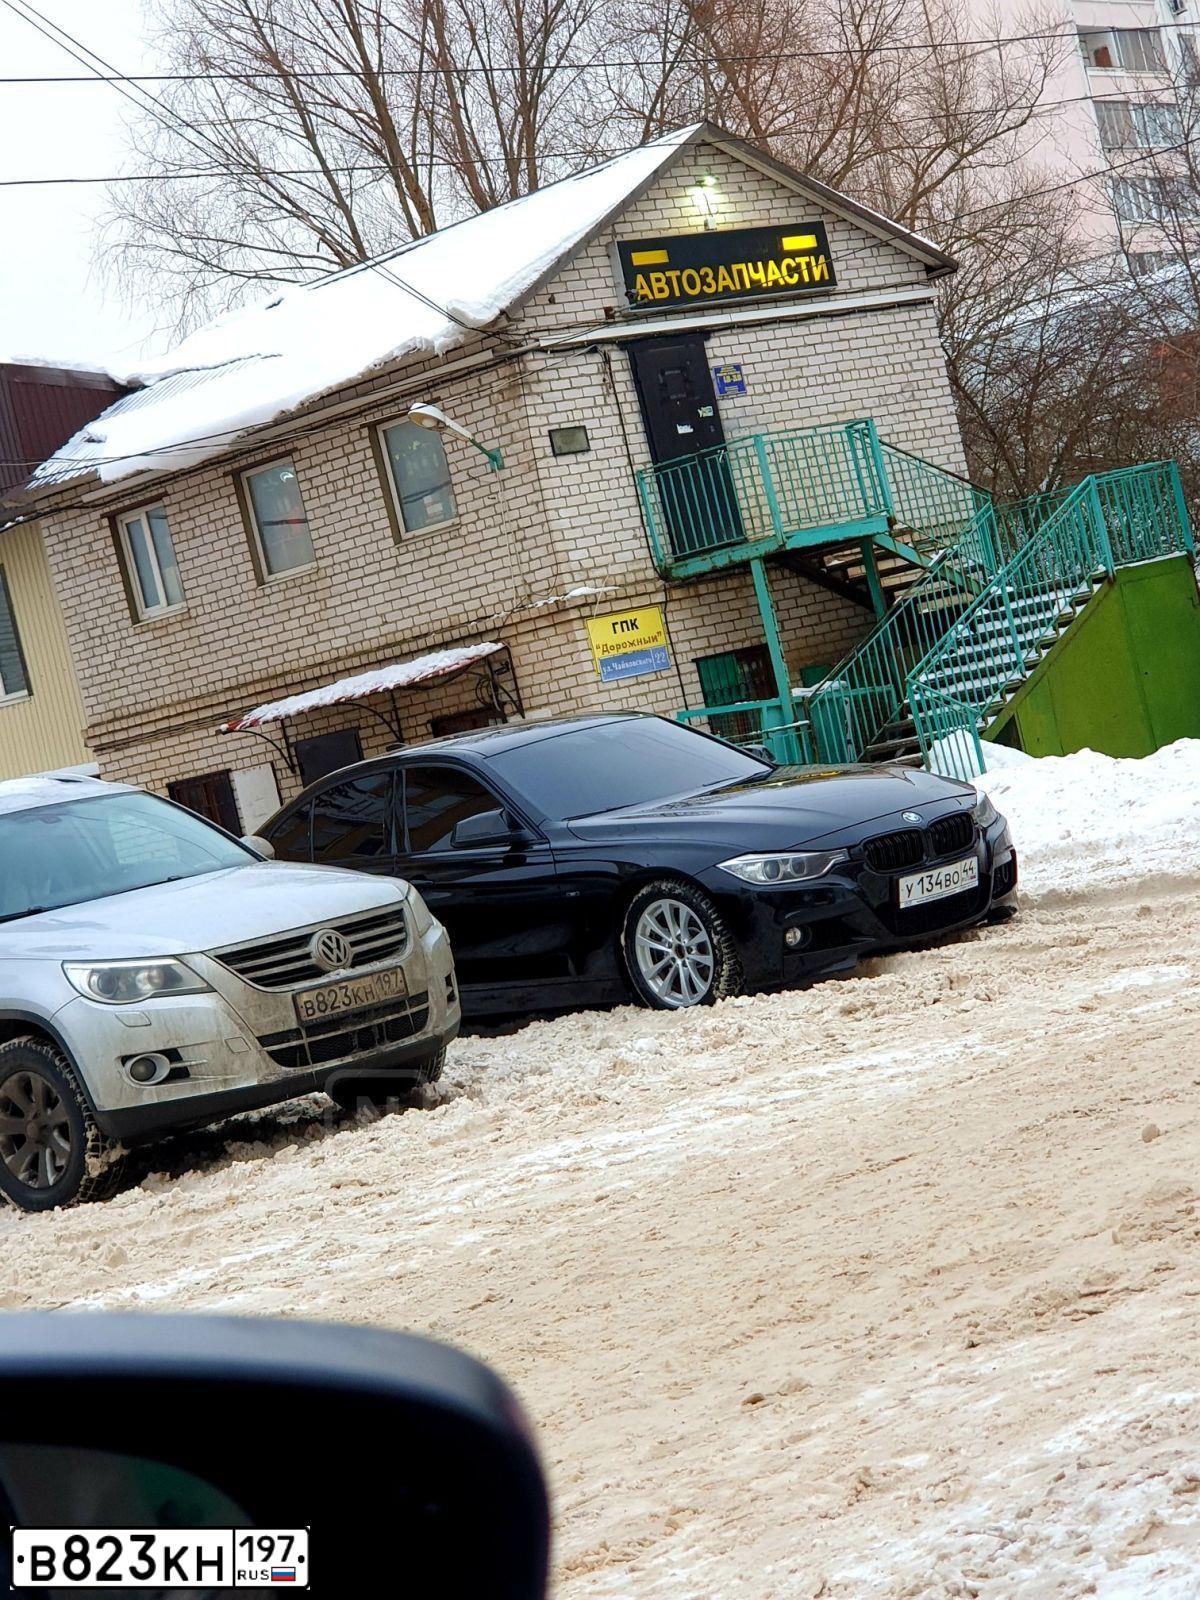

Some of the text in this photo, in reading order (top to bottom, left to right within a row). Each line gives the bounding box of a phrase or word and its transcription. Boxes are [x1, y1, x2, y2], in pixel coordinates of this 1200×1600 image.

[635, 255, 828, 299] АВТОЗАПЧАСТИ
[611, 618, 639, 634] ГПК
[376, 971, 399, 991] 197
